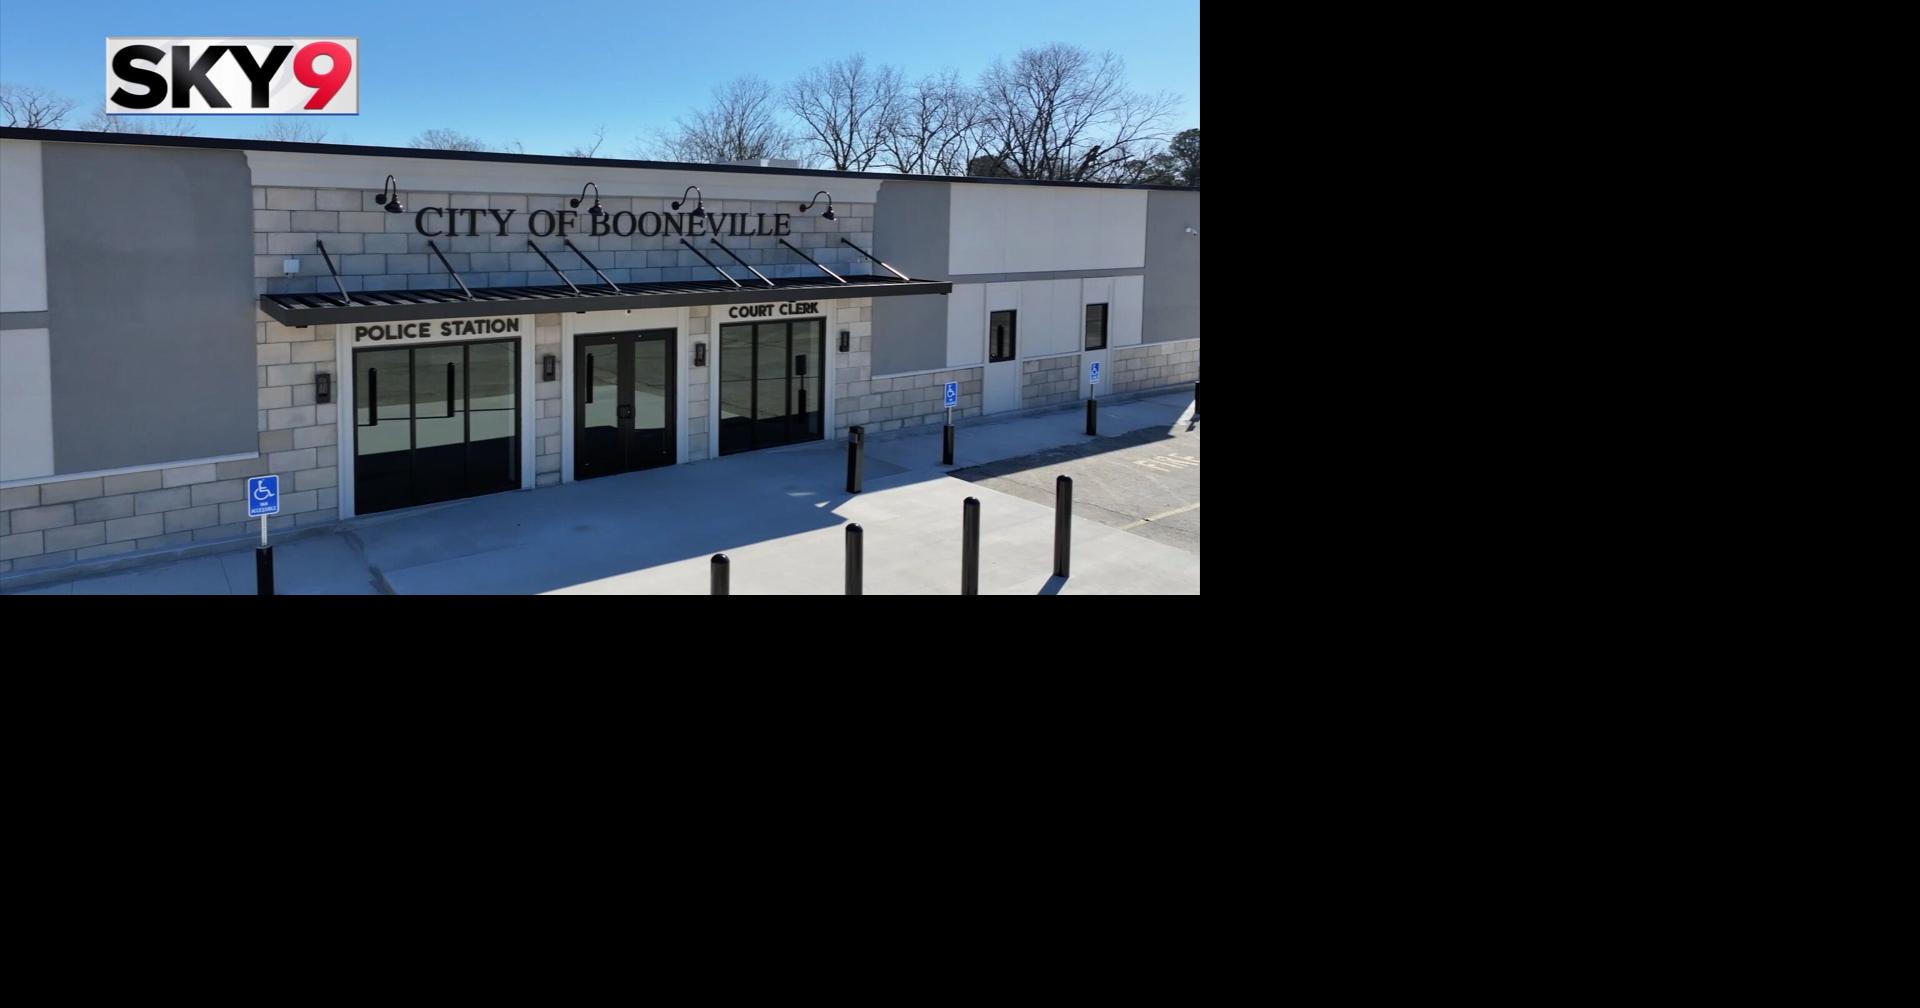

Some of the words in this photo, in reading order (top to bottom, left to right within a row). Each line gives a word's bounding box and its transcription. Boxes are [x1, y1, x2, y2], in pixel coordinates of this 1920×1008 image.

[415, 206, 516, 237] CITY
[528, 209, 578, 237] OF
[588, 210, 791, 237] BOONEVILLE
[728, 304, 775, 318] COURT
[779, 302, 819, 315] CLERK
[355, 322, 431, 342] POLICE
[440, 318, 519, 337] STATION
